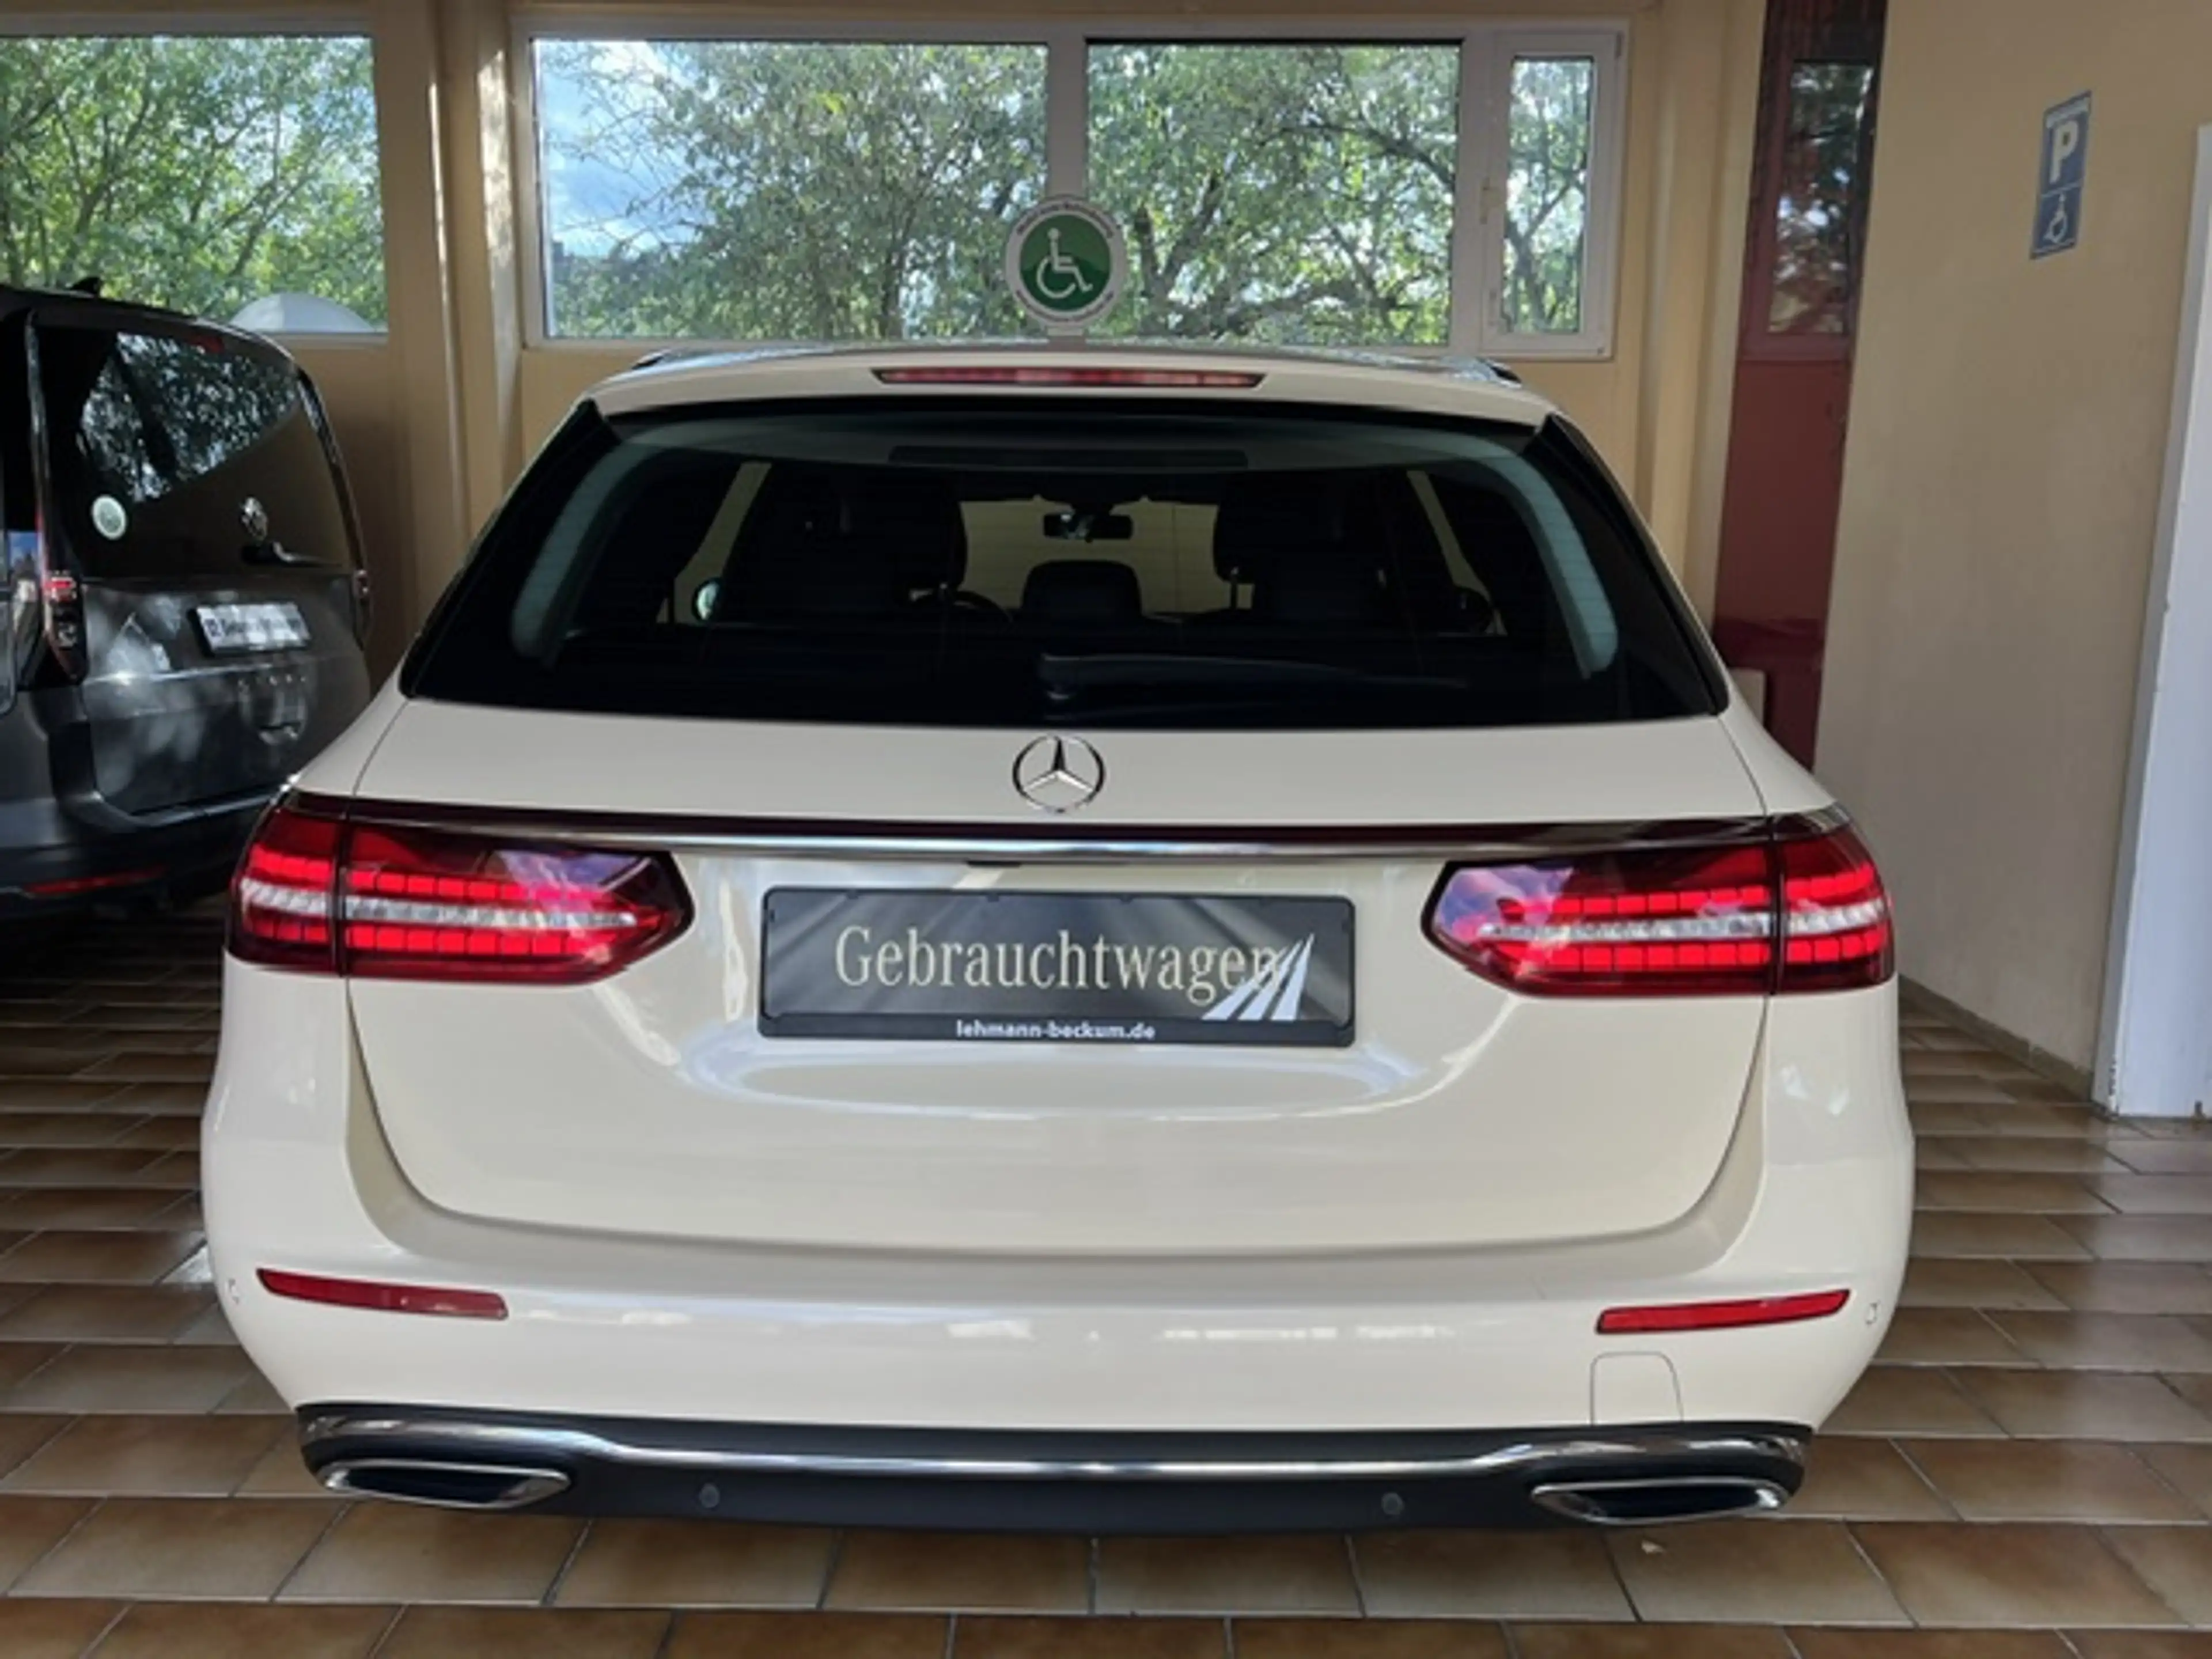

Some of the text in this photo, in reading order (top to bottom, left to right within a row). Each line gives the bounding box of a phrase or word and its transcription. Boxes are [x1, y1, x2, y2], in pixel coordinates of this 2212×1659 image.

[2050, 120, 2078, 184] P
[836, 925, 1281, 1006] Gebrauchtwagen
[956, 1018, 1156, 1039] lehmann-beckum.de
